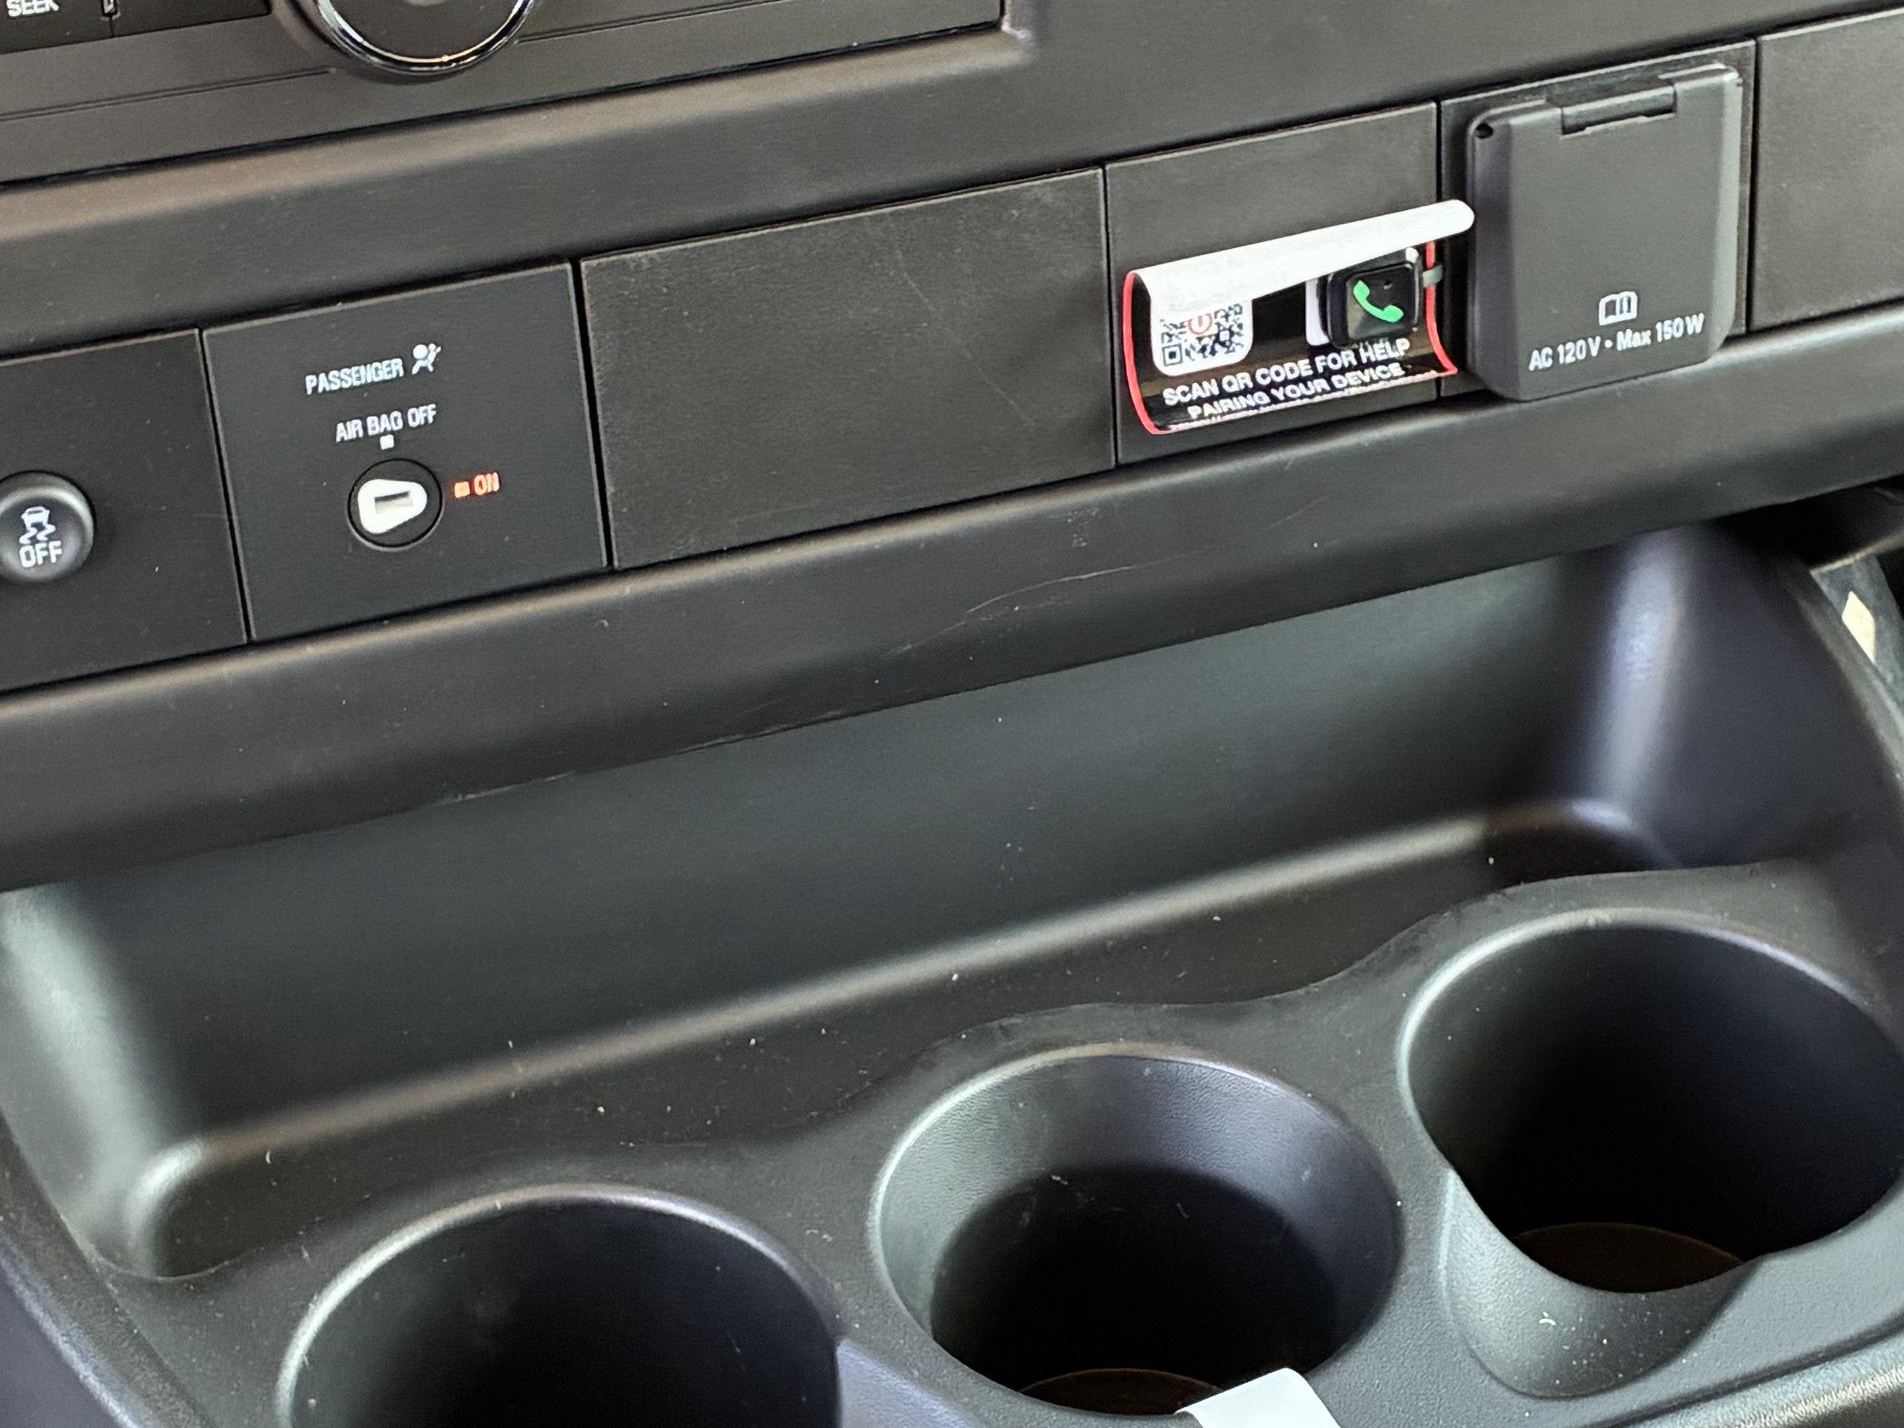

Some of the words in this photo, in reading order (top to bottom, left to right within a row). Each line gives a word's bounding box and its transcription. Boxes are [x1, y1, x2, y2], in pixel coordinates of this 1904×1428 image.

[1528, 347, 1553, 371] AC
[1616, 328, 1652, 351] Max
[305, 358, 405, 395] PASSENGER
[1162, 378, 1220, 407] SCAN
[1222, 371, 1254, 392] QR
[1256, 358, 1314, 384] CODE
[1315, 348, 1358, 377] FOR
[1360, 336, 1411, 362] HELP
[1187, 393, 1271, 420] PAIRING
[1272, 378, 1330, 402] YOUR
[1332, 363, 1406, 390] DEVICE
[335, 419, 364, 443] AIR
[366, 411, 403, 436] BAG
[407, 403, 437, 428] OFF
[474, 472, 500, 496] ON
[19, 540, 62, 568] OFF
